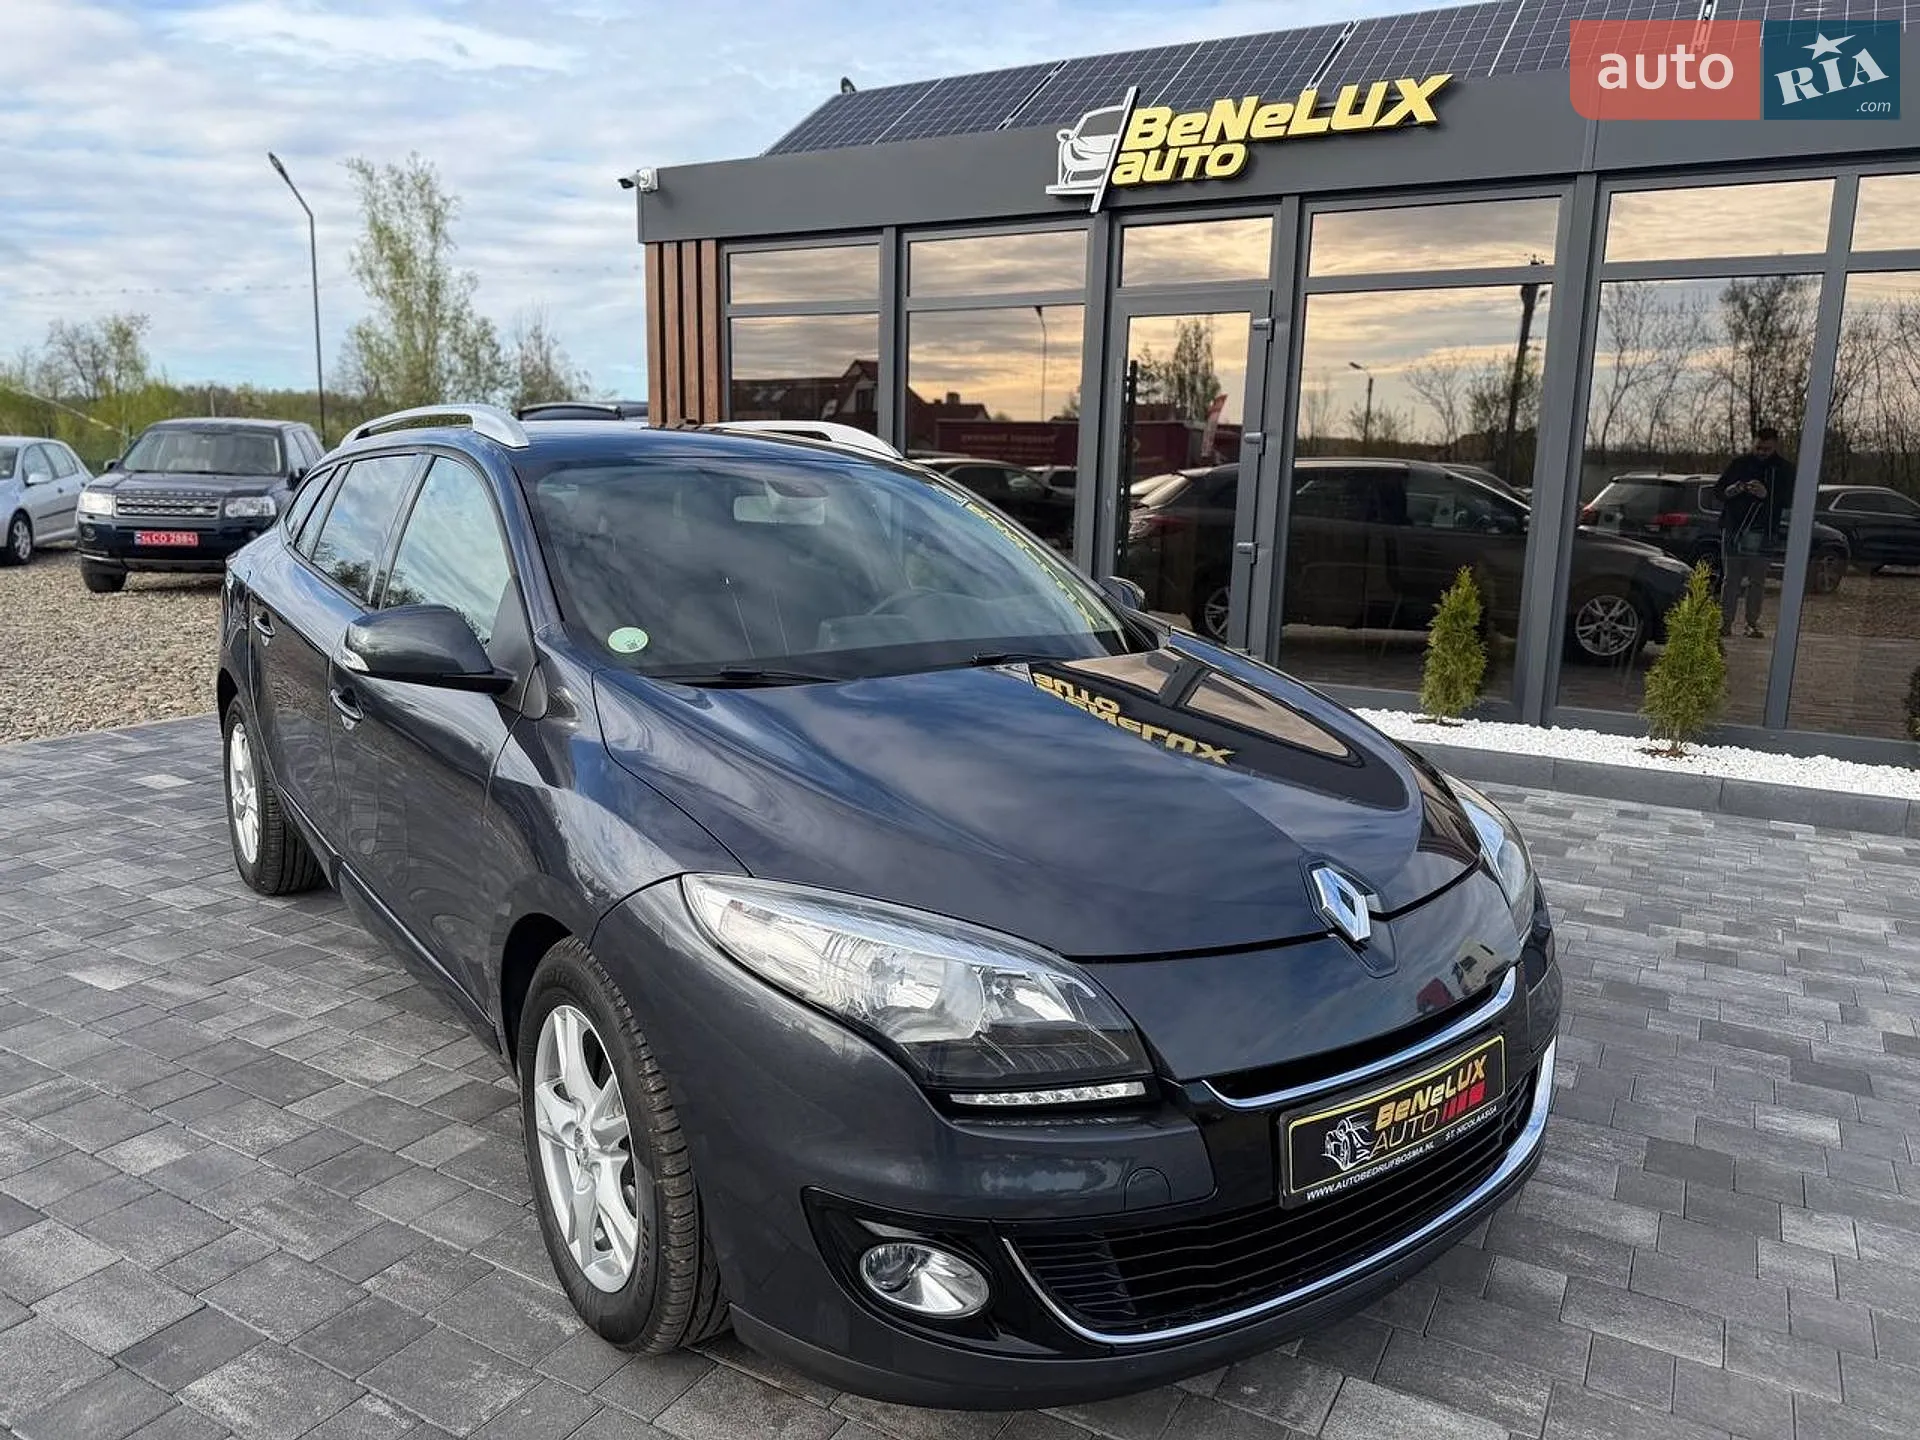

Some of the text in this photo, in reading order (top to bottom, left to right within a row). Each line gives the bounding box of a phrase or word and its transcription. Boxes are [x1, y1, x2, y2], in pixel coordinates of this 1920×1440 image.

[1122, 73, 1453, 151] BeNeLUX
[1375, 1055, 1487, 1131] BeNeLUX
[1371, 1108, 1439, 1156] AUTO
